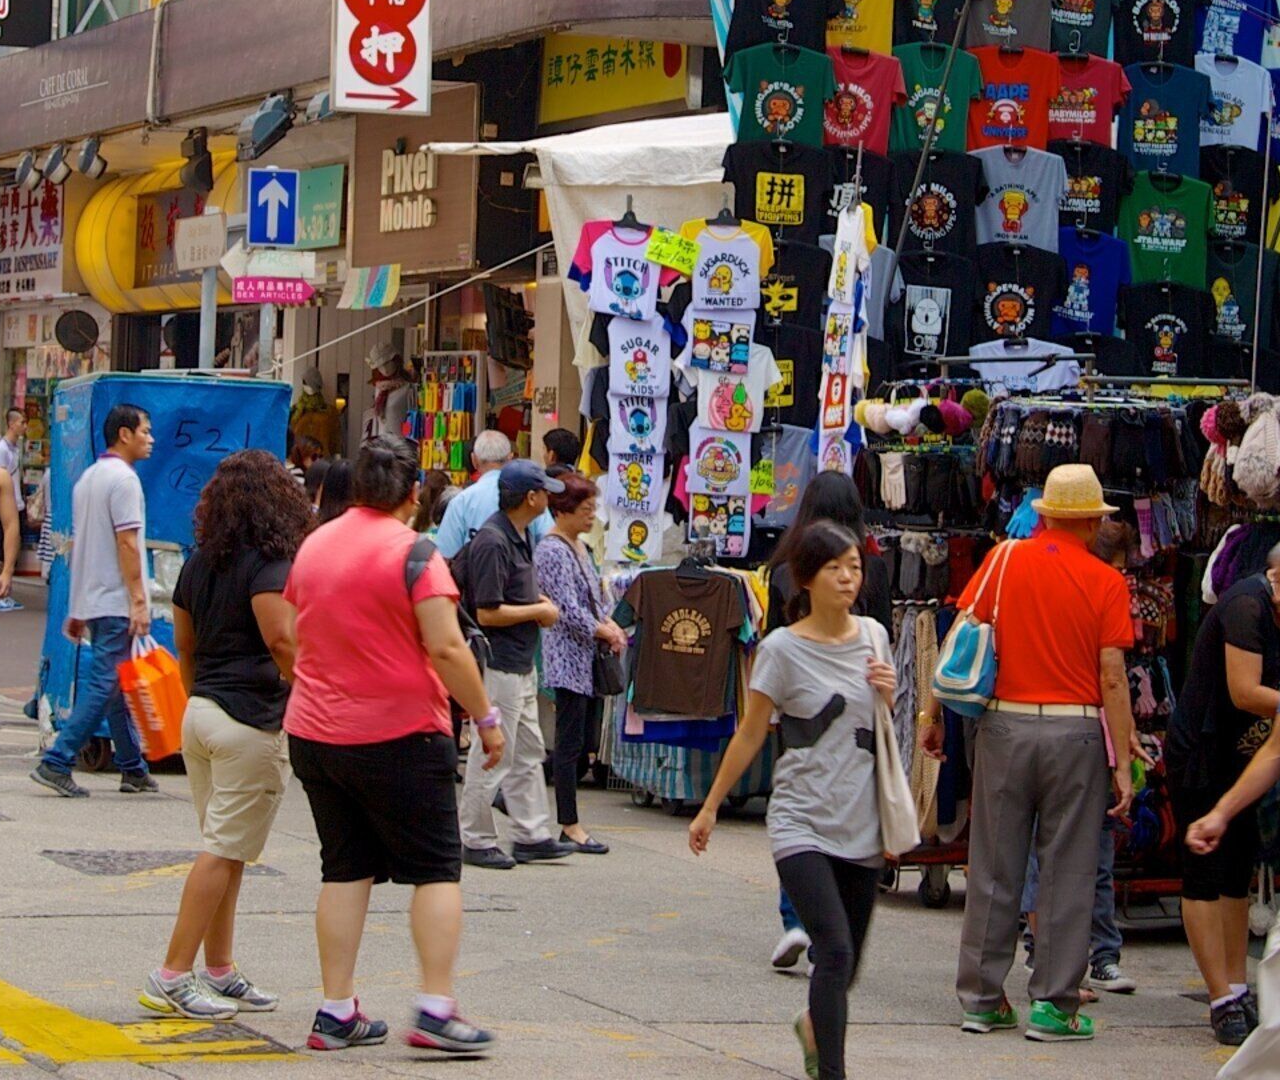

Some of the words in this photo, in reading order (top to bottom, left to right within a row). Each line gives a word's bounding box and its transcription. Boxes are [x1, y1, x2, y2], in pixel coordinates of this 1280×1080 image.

[360, 25, 405, 73] 押
[985, 83, 1029, 100] AAPE
[766, 176, 795, 209] 拼
[380, 195, 436, 232] Mobile
[606, 257, 649, 275] STITCH
[699, 253, 751, 279] SUGARDUCK
[236, 280, 304, 292] 成人用品專門店
[237, 291, 254, 299] SEX
[260, 292, 303, 300] ARTICLES
[620, 336, 660, 357] SUGAR
[174, 420, 251, 452] 521
[616, 496, 651, 512] PUPPET
